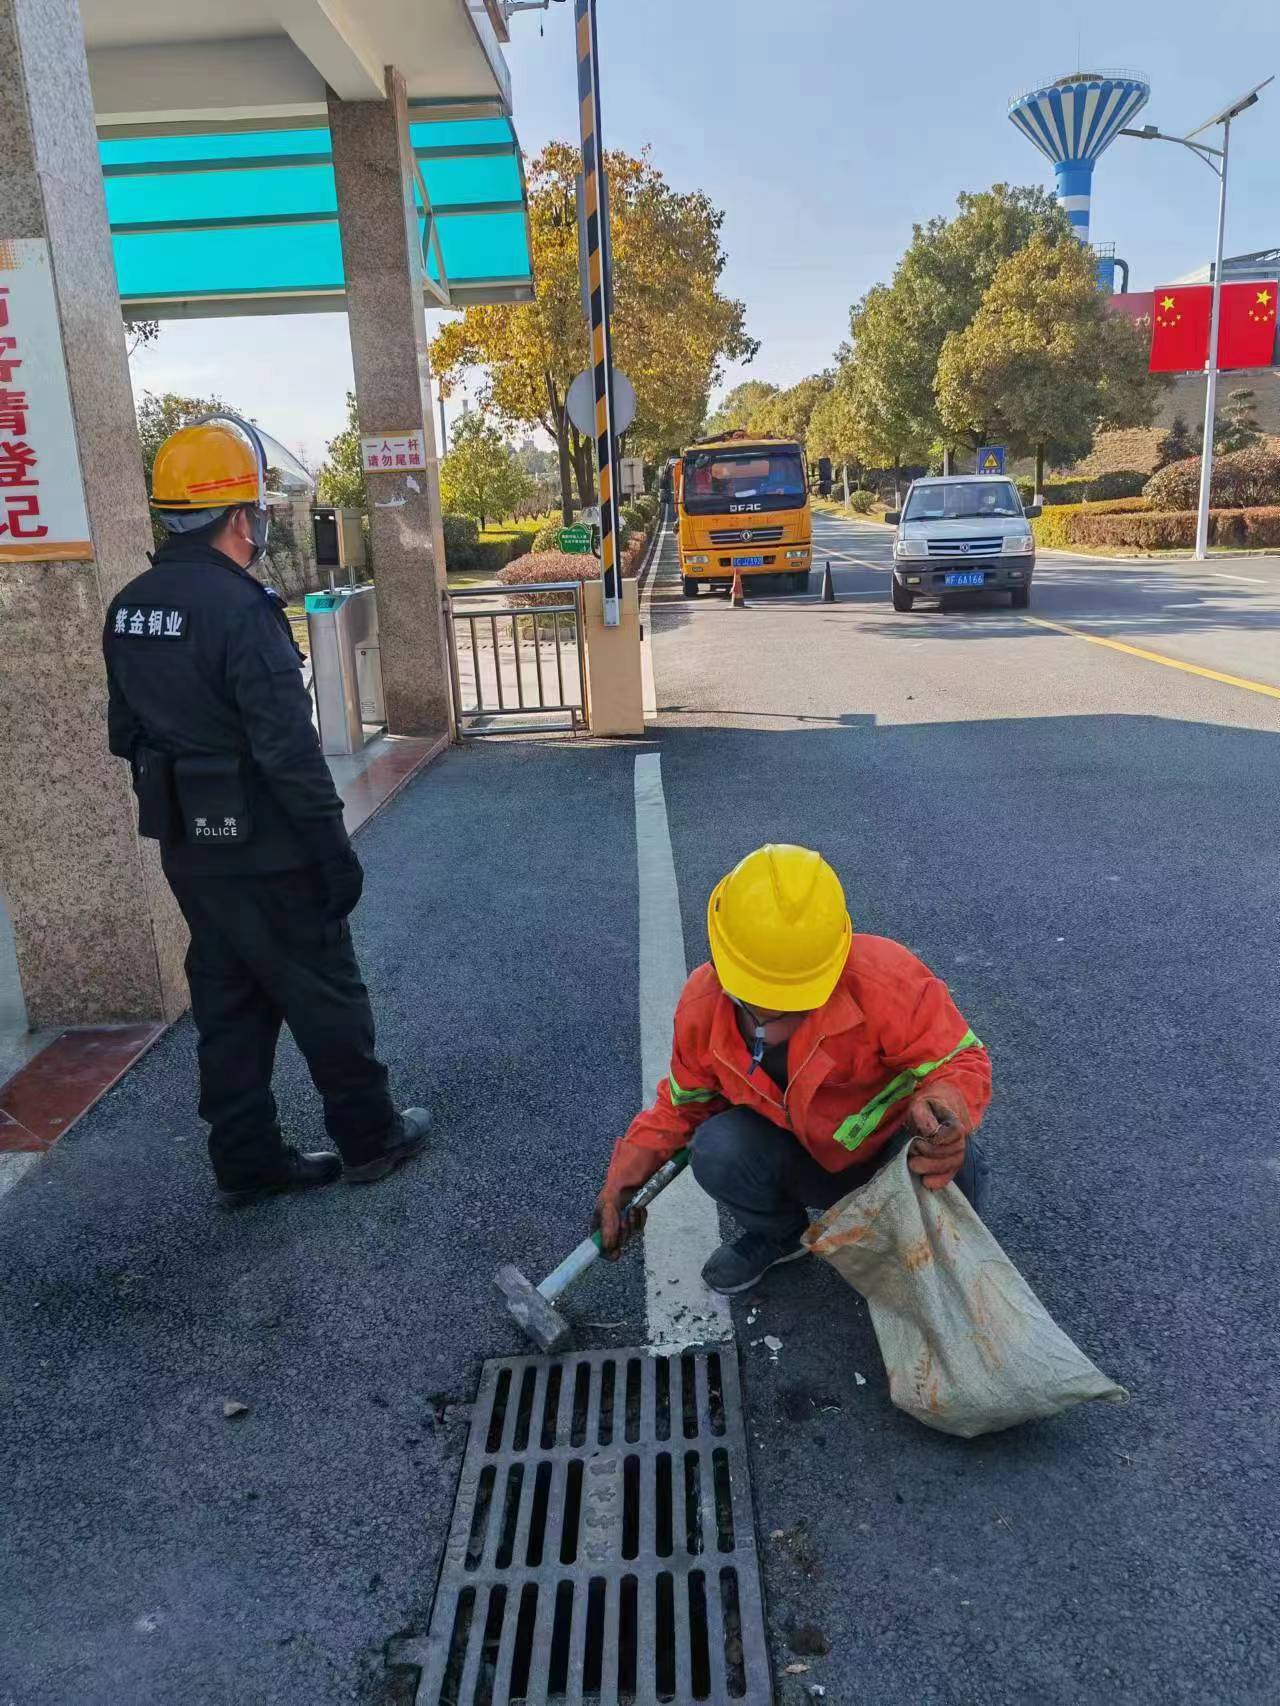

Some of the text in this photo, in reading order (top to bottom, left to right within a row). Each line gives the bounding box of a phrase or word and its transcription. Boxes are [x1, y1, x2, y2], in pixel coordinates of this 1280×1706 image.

[366, 439, 419, 452] 一人一杆
[368, 453, 421, 467] 请勿尾随
[729, 503, 761, 512] DFAC
[114, 608, 183, 636] 紫金铜业
[195, 827, 238, 836] POLICE
